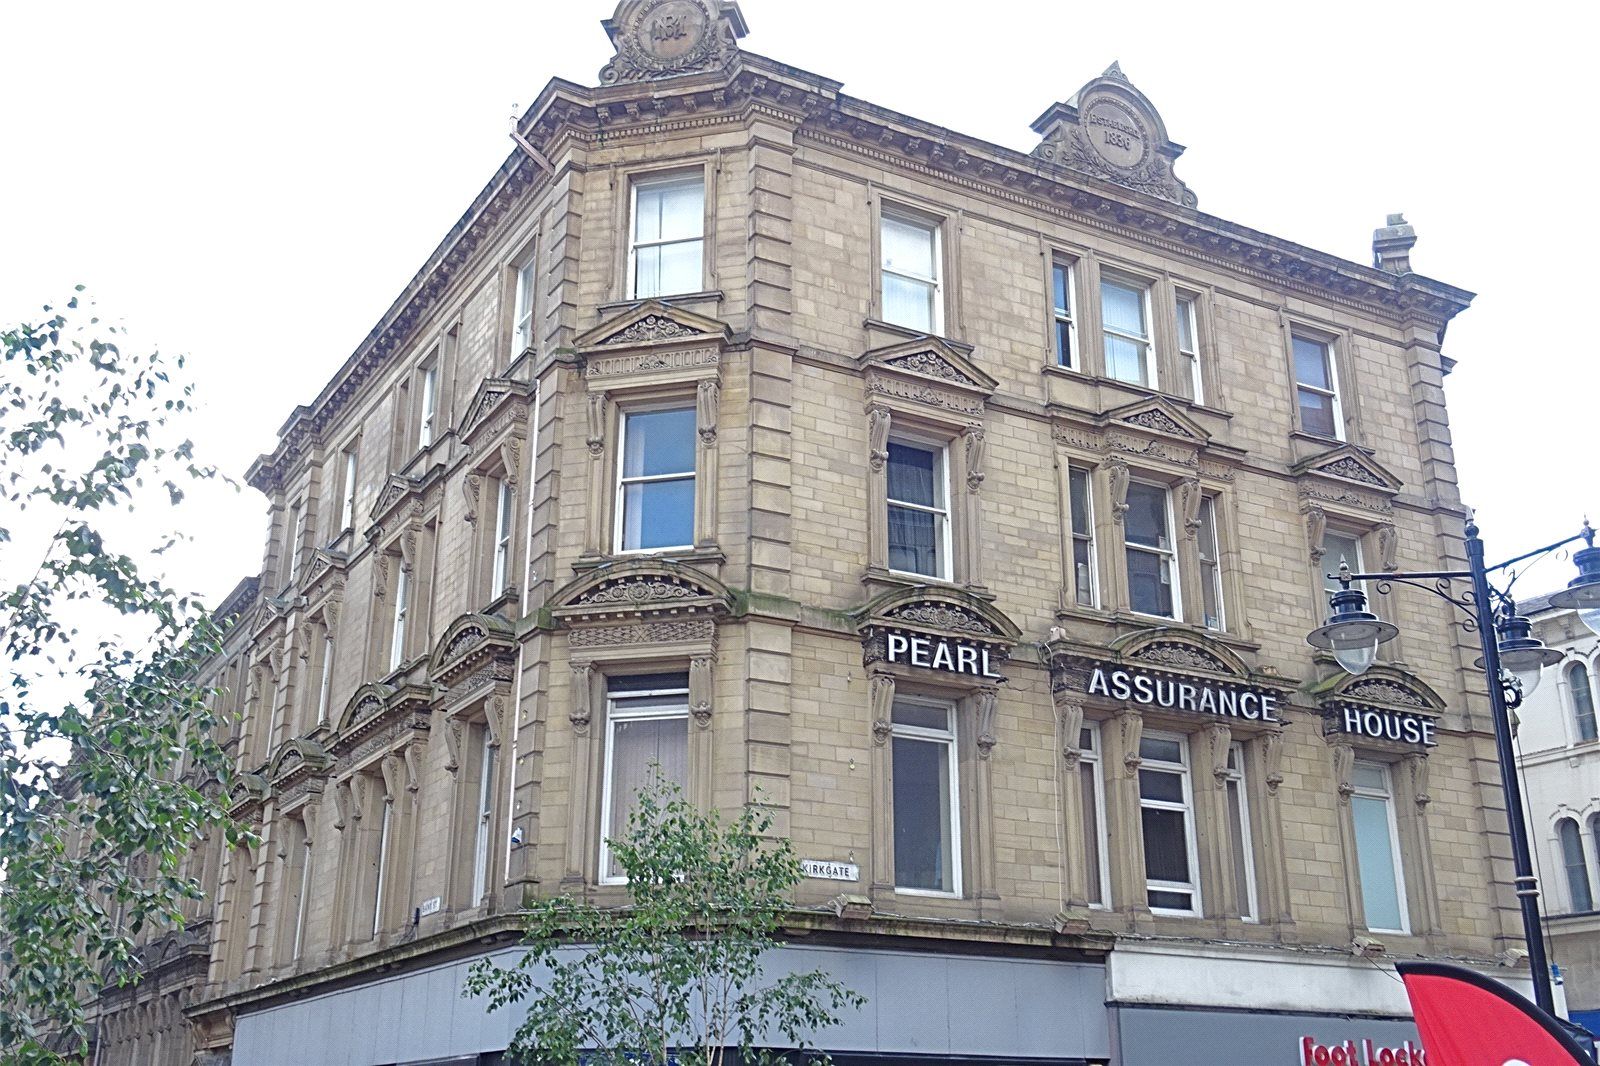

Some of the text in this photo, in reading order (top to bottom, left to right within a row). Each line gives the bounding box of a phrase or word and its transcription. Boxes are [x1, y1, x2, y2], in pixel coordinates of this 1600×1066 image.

[888, 633, 1000, 678] PEARL
[1088, 668, 1279, 722] ASSURANCE
[1343, 707, 1438, 746] HOUSE
[802, 863, 850, 877] KIRKGATE
[1362, 1039, 1427, 1066] Lock
